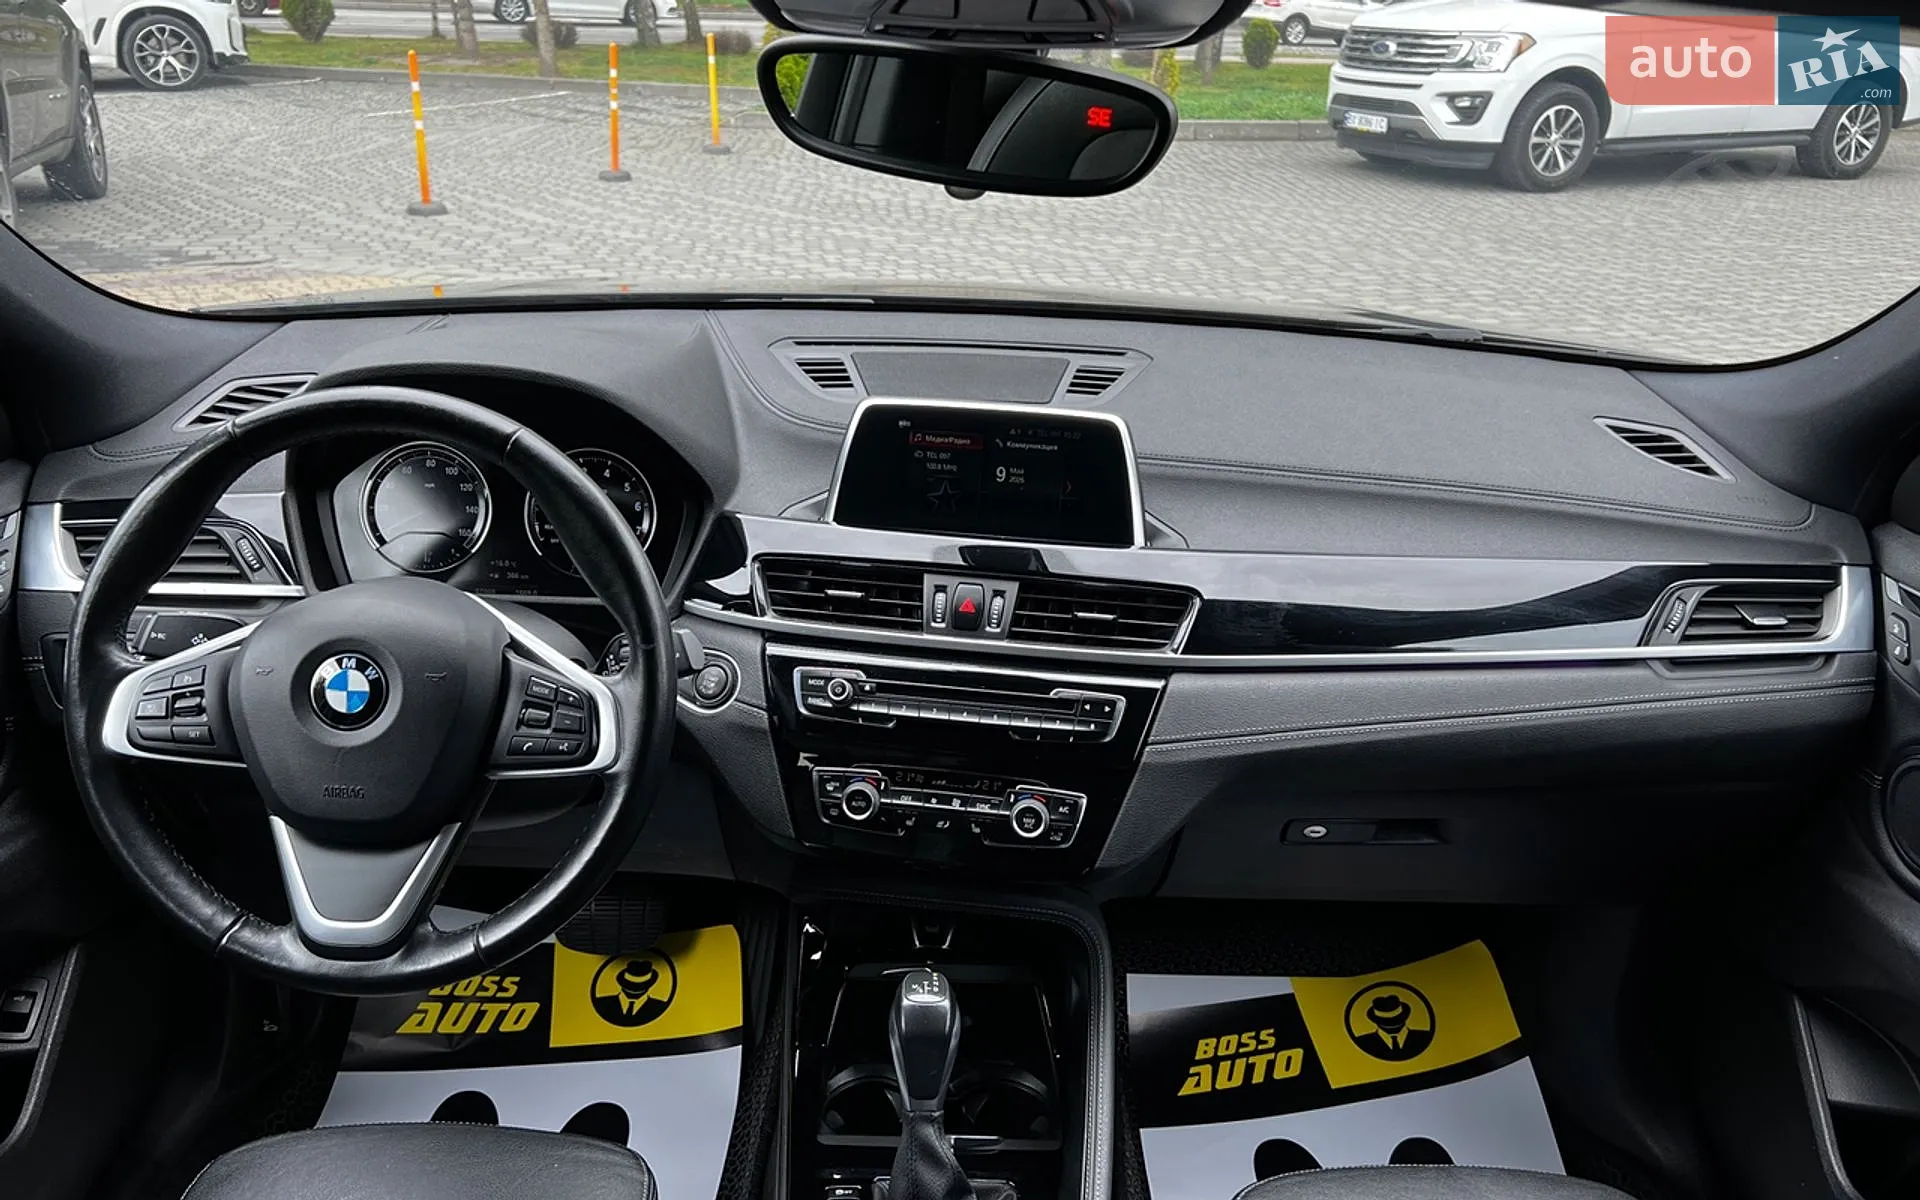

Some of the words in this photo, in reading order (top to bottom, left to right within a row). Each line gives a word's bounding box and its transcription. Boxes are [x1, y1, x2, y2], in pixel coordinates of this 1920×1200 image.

[1087, 106, 1112, 127] SE
[425, 459, 437, 468] 80
[401, 465, 412, 474] 60
[445, 466, 459, 475] 100
[603, 468, 611, 478] 4
[996, 466, 1006, 482] 9
[460, 483, 474, 492] 120
[624, 481, 631, 492] 5
[465, 505, 479, 514] 140
[634, 501, 642, 512] 6
[635, 525, 642, 536] 7
[320, 656, 379, 681] BMW
[322, 783, 365, 800] AIRBAG
[395, 1001, 541, 1034] AUTO
[1195, 1028, 1277, 1060] BOSS
[1177, 1047, 1305, 1096] AUTO
